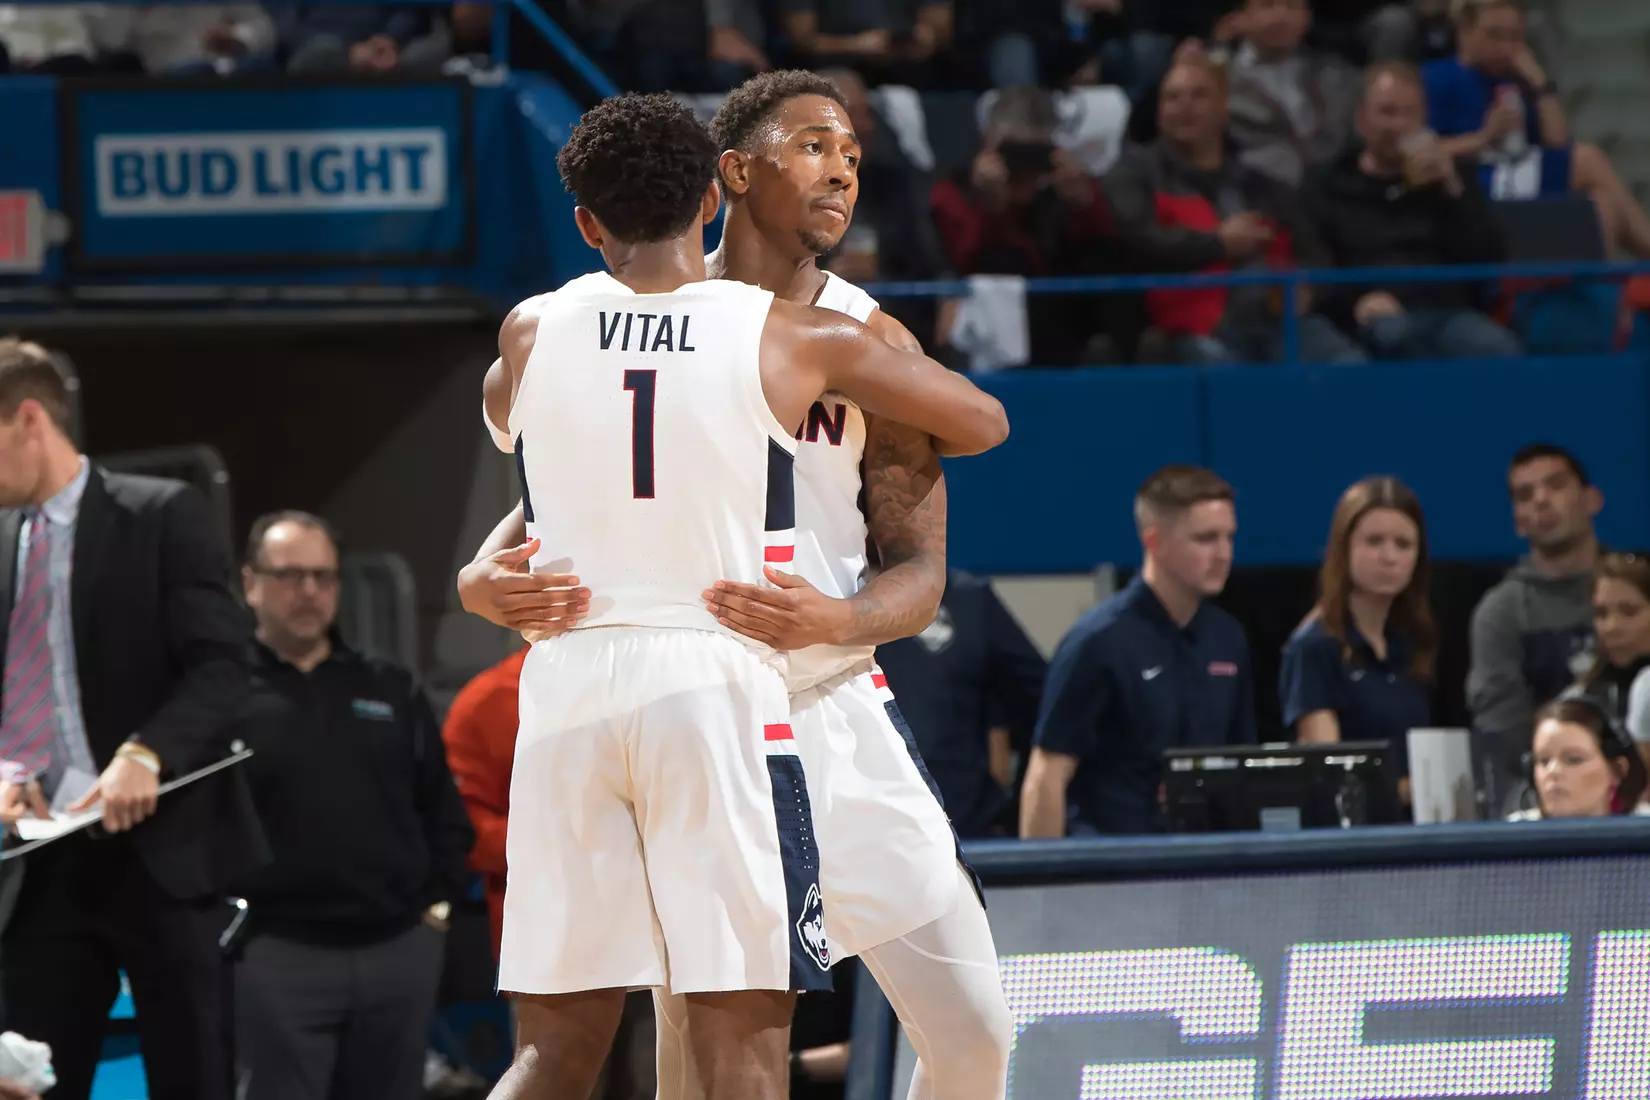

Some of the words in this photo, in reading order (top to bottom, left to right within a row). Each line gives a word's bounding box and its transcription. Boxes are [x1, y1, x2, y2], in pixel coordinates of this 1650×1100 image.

[110, 148, 239, 199] BUD
[252, 144, 430, 197] LIGHT
[599, 311, 695, 352] VITAL
[623, 369, 657, 499] 1
[795, 400, 846, 446] N
